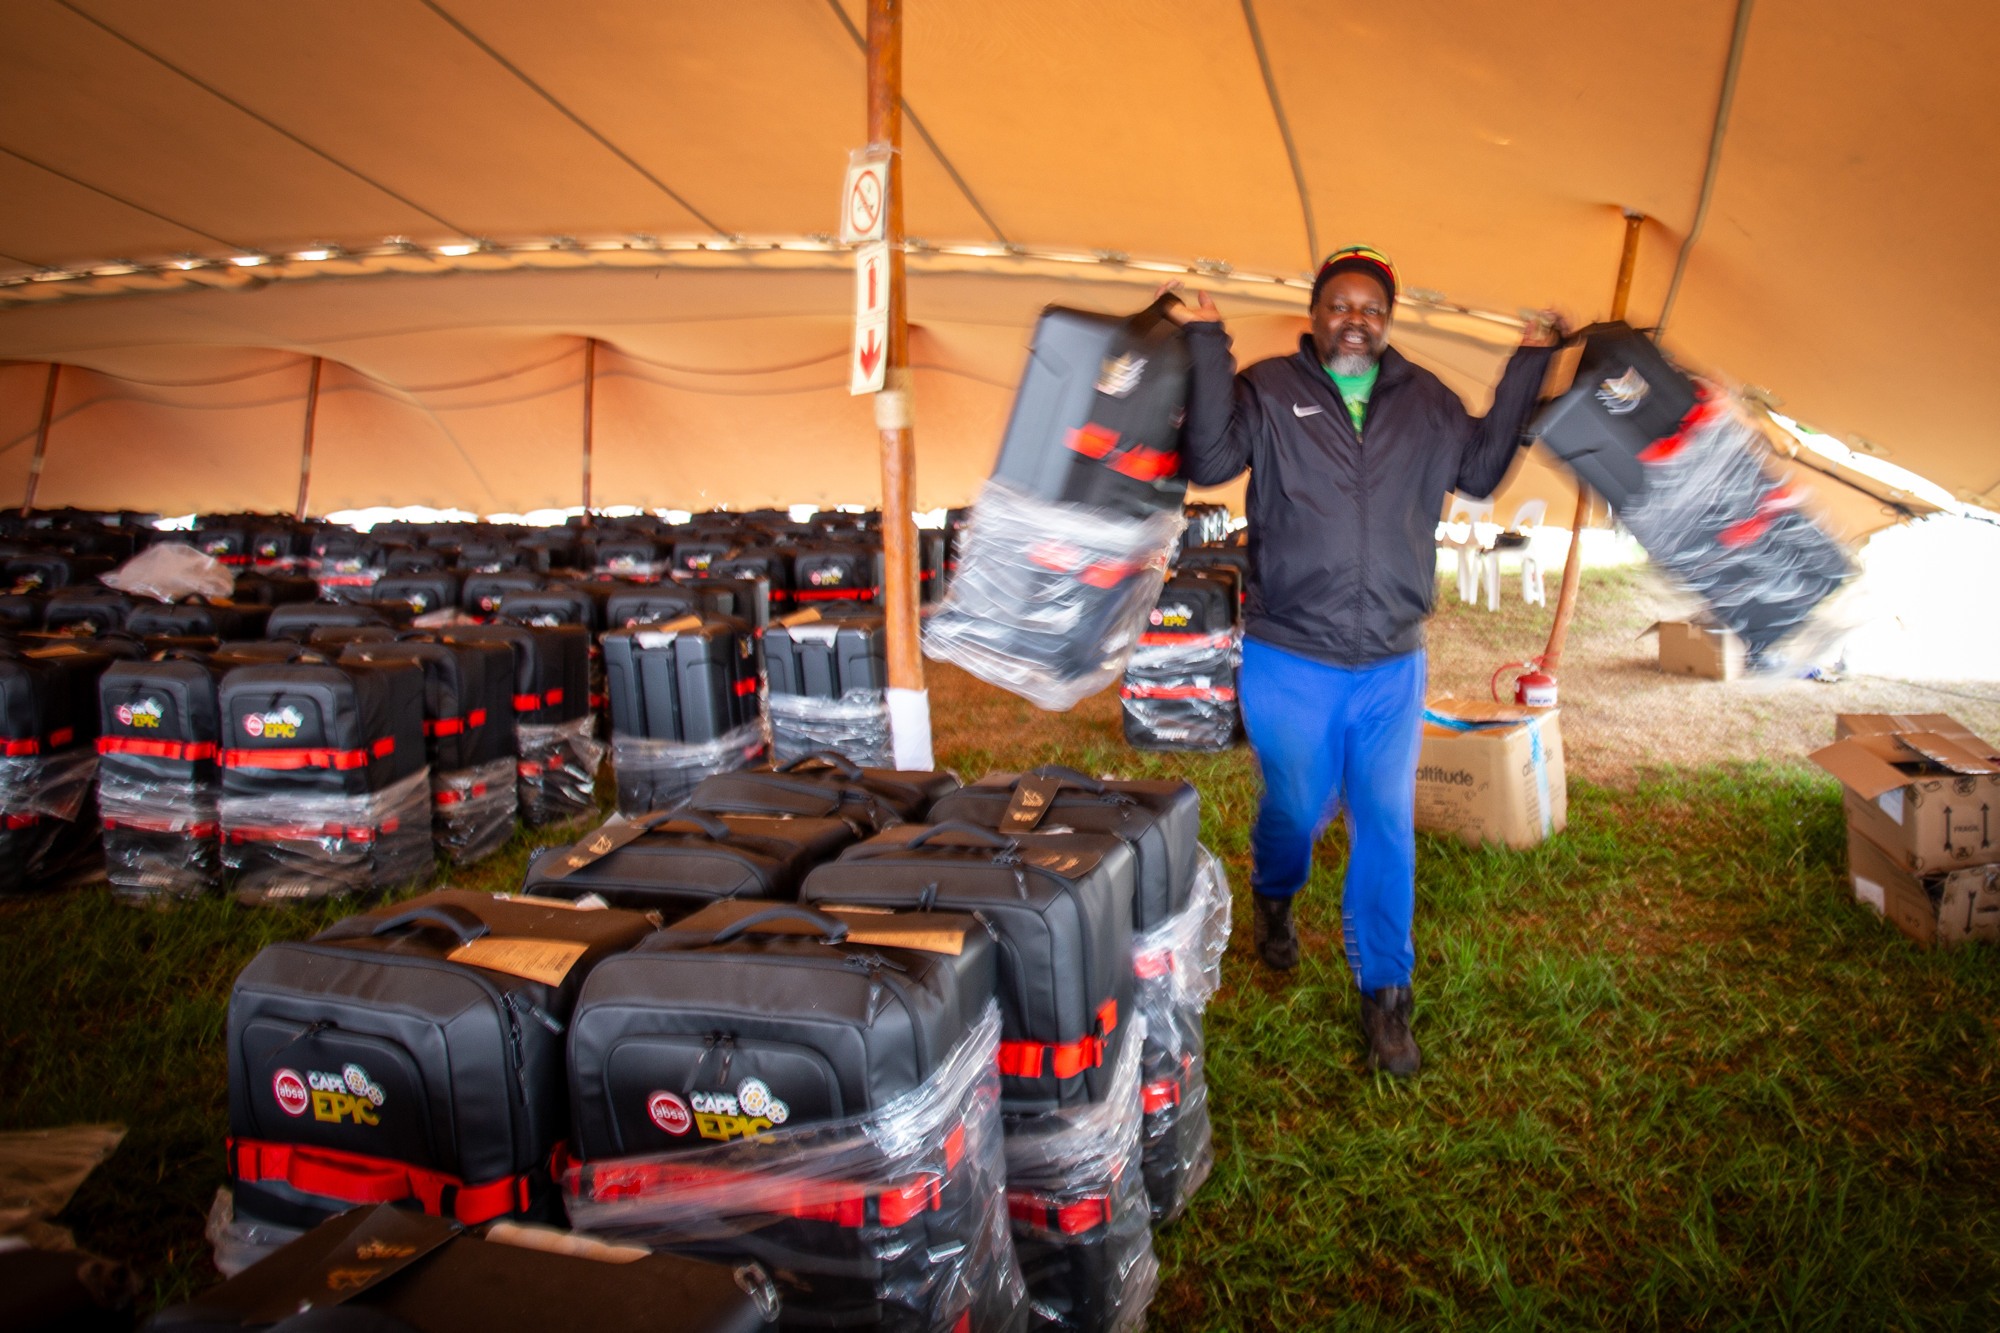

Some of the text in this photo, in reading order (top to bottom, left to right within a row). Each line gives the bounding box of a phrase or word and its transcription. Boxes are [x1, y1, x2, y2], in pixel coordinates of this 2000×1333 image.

[132, 714, 160, 728] EPIC
[264, 723, 297, 738] EPIC
[1416, 765, 1474, 787] altitude
[280, 1083, 305, 1100] absa
[308, 1070, 348, 1094] CAPE
[311, 1091, 380, 1126] EPIC
[656, 1105, 687, 1121] absa
[690, 1092, 739, 1117] CAPE
[694, 1111, 776, 1144] EPIC
